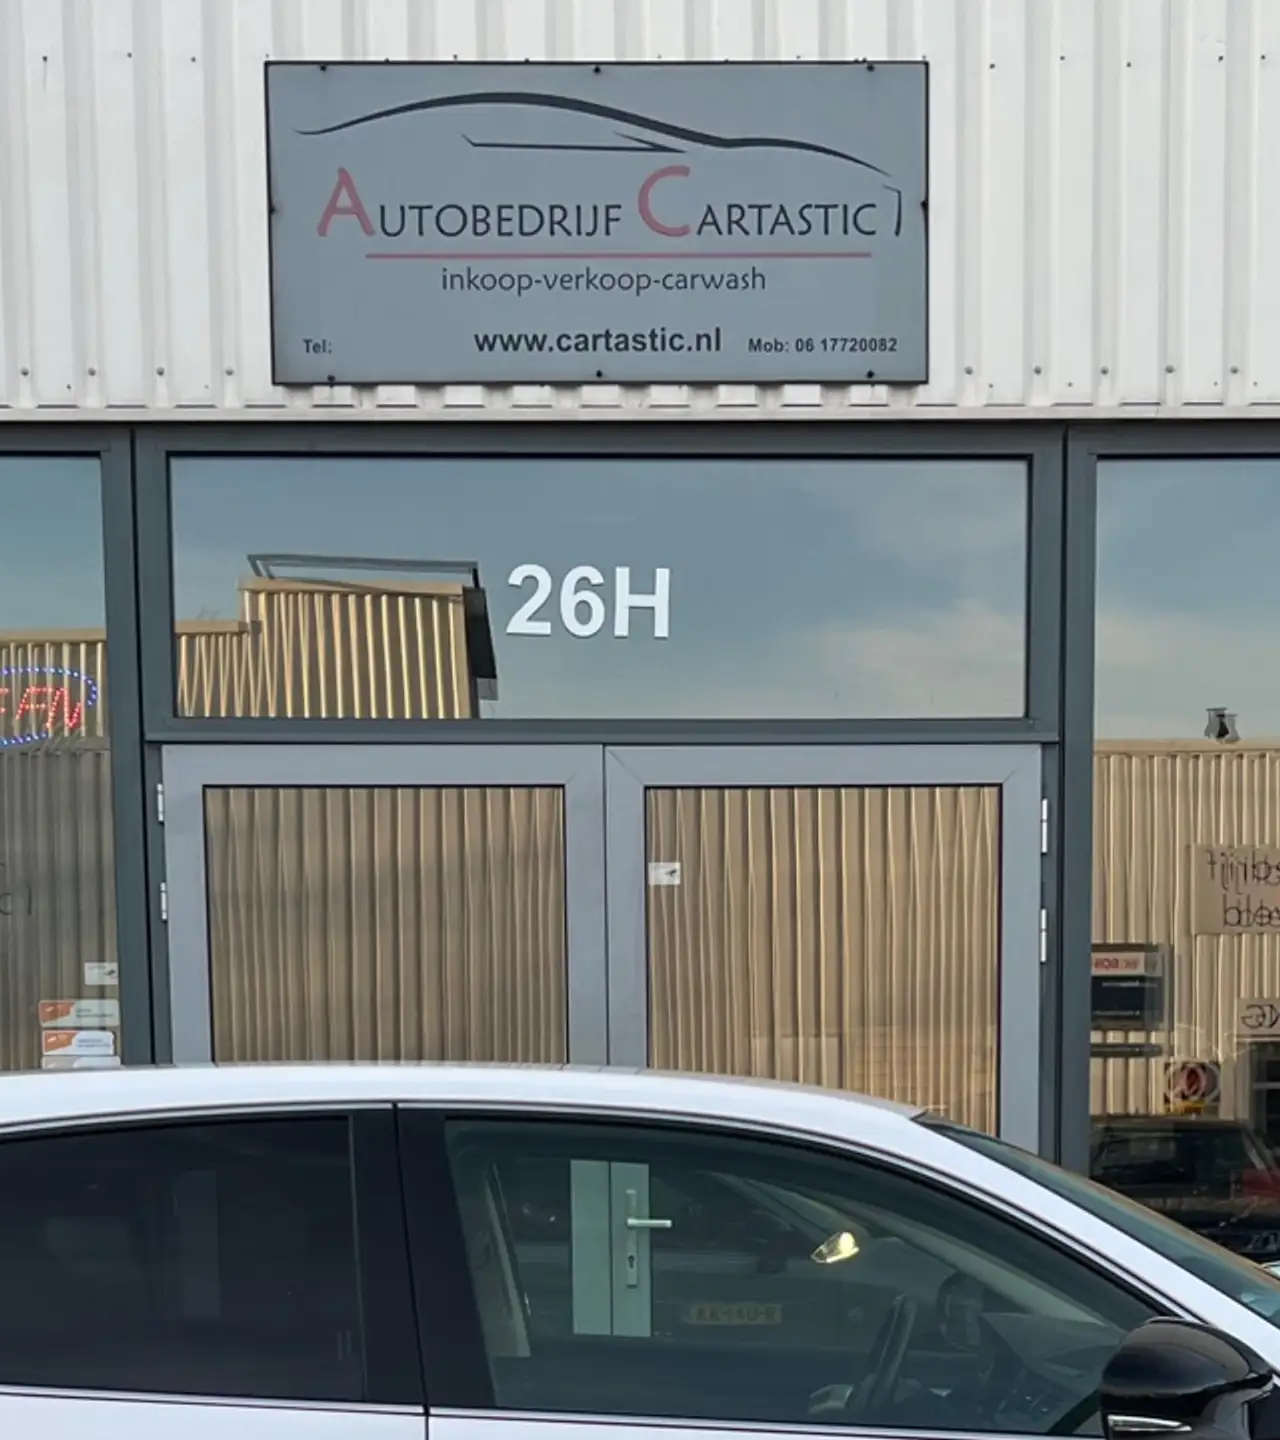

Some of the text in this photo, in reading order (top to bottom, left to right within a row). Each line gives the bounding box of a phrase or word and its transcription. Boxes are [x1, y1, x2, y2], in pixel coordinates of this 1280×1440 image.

[317, 165, 878, 238] AUTOBEDRIJF CARTASTIC
[441, 266, 766, 296] inkoop-verkoop-carwash
[302, 338, 333, 355] Tel:
[473, 326, 722, 353] www.cartastic.nl
[748, 338, 898, 354] Mob: 06 17720082
[505, 563, 671, 640] 26H
